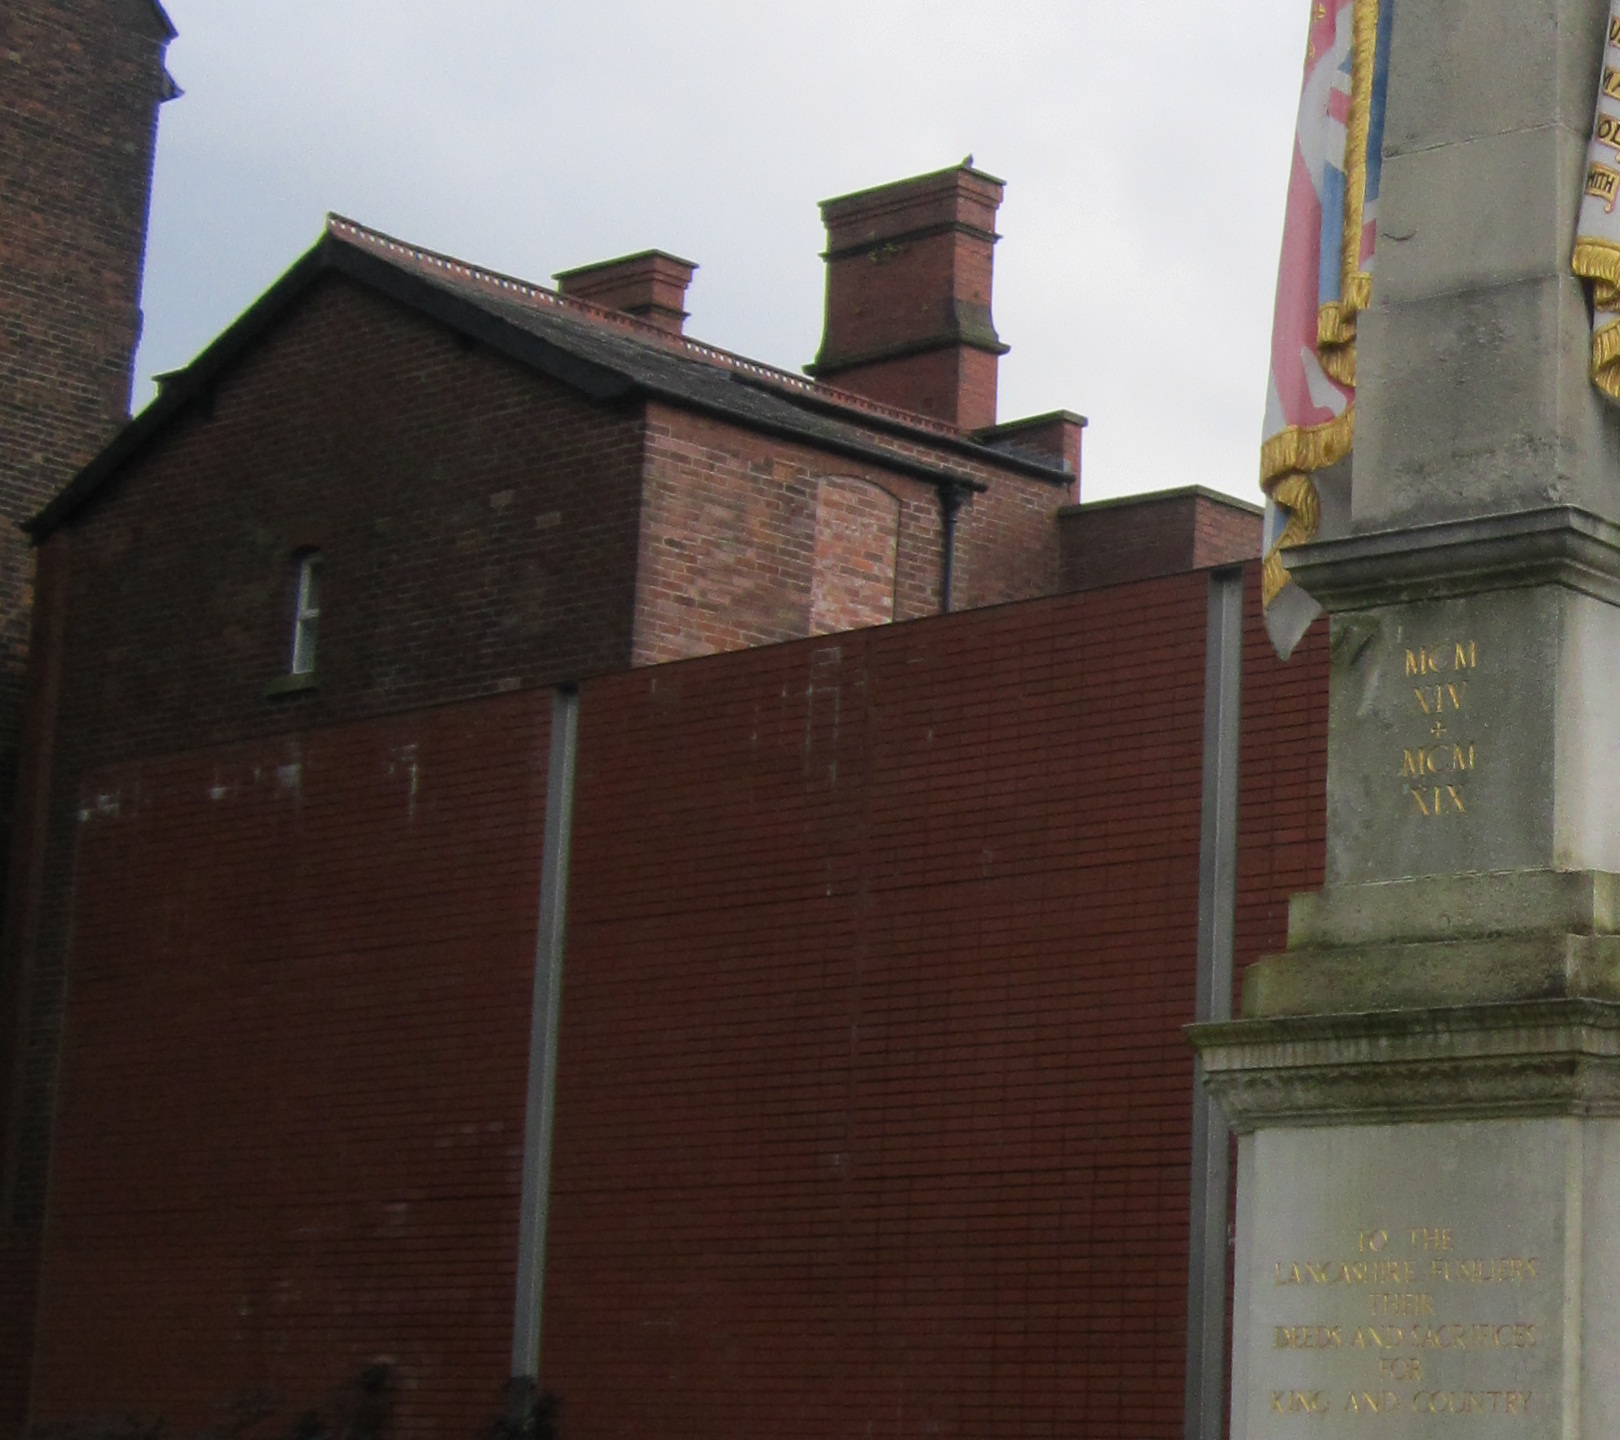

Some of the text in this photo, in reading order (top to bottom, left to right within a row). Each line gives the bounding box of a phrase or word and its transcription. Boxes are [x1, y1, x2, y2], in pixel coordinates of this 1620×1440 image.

[1405, 640, 1476, 677] MCM
[1412, 680, 1468, 715] XIV
[1402, 741, 1475, 777] MCM
[1407, 783, 1466, 817] XIX
[1354, 1227, 1453, 1252] TO THE
[1274, 1257, 1539, 1286] LANCASHIRE FUSILIERS
[1368, 1292, 1435, 1316] THEIR
[1272, 1324, 1537, 1350] DEEDS AND SACRIFICES
[1379, 1357, 1424, 1382] FOR
[1270, 1390, 1533, 1415] KING AND COUNTRY
